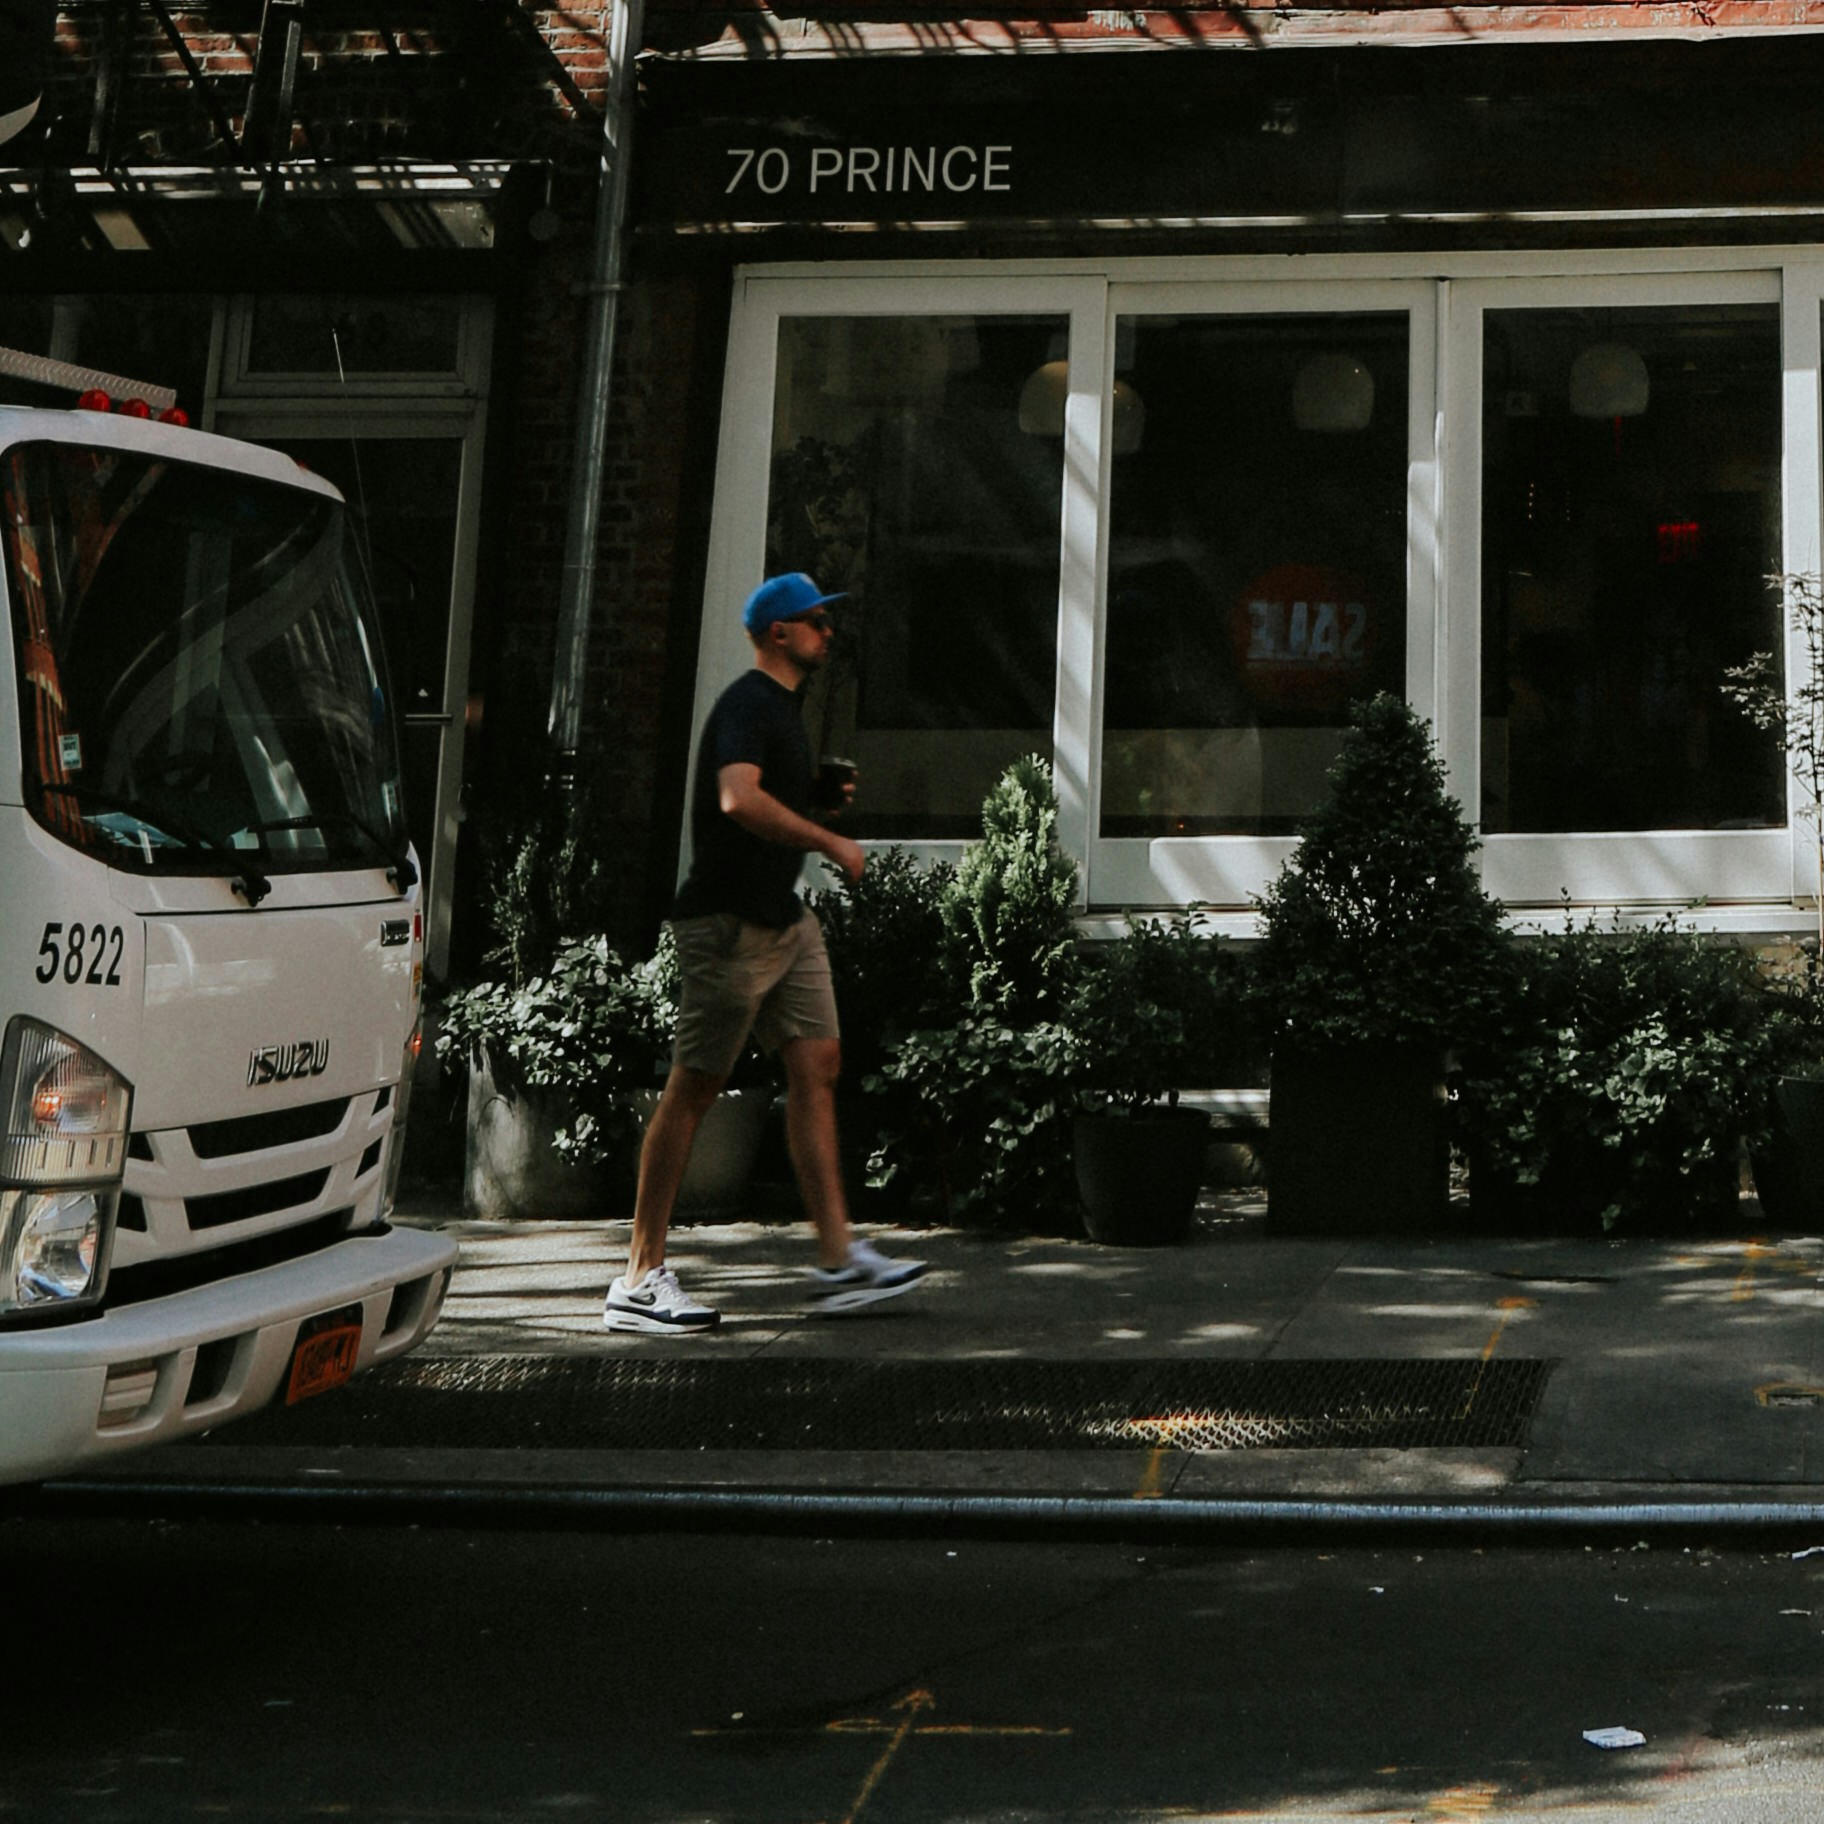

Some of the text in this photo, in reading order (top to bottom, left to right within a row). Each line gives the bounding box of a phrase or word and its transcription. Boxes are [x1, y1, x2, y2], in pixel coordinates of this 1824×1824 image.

[724, 145, 1013, 194] 70 PRINCE
[35, 922, 124, 986] 5822
[246, 1038, 329, 1088] ISUZU
